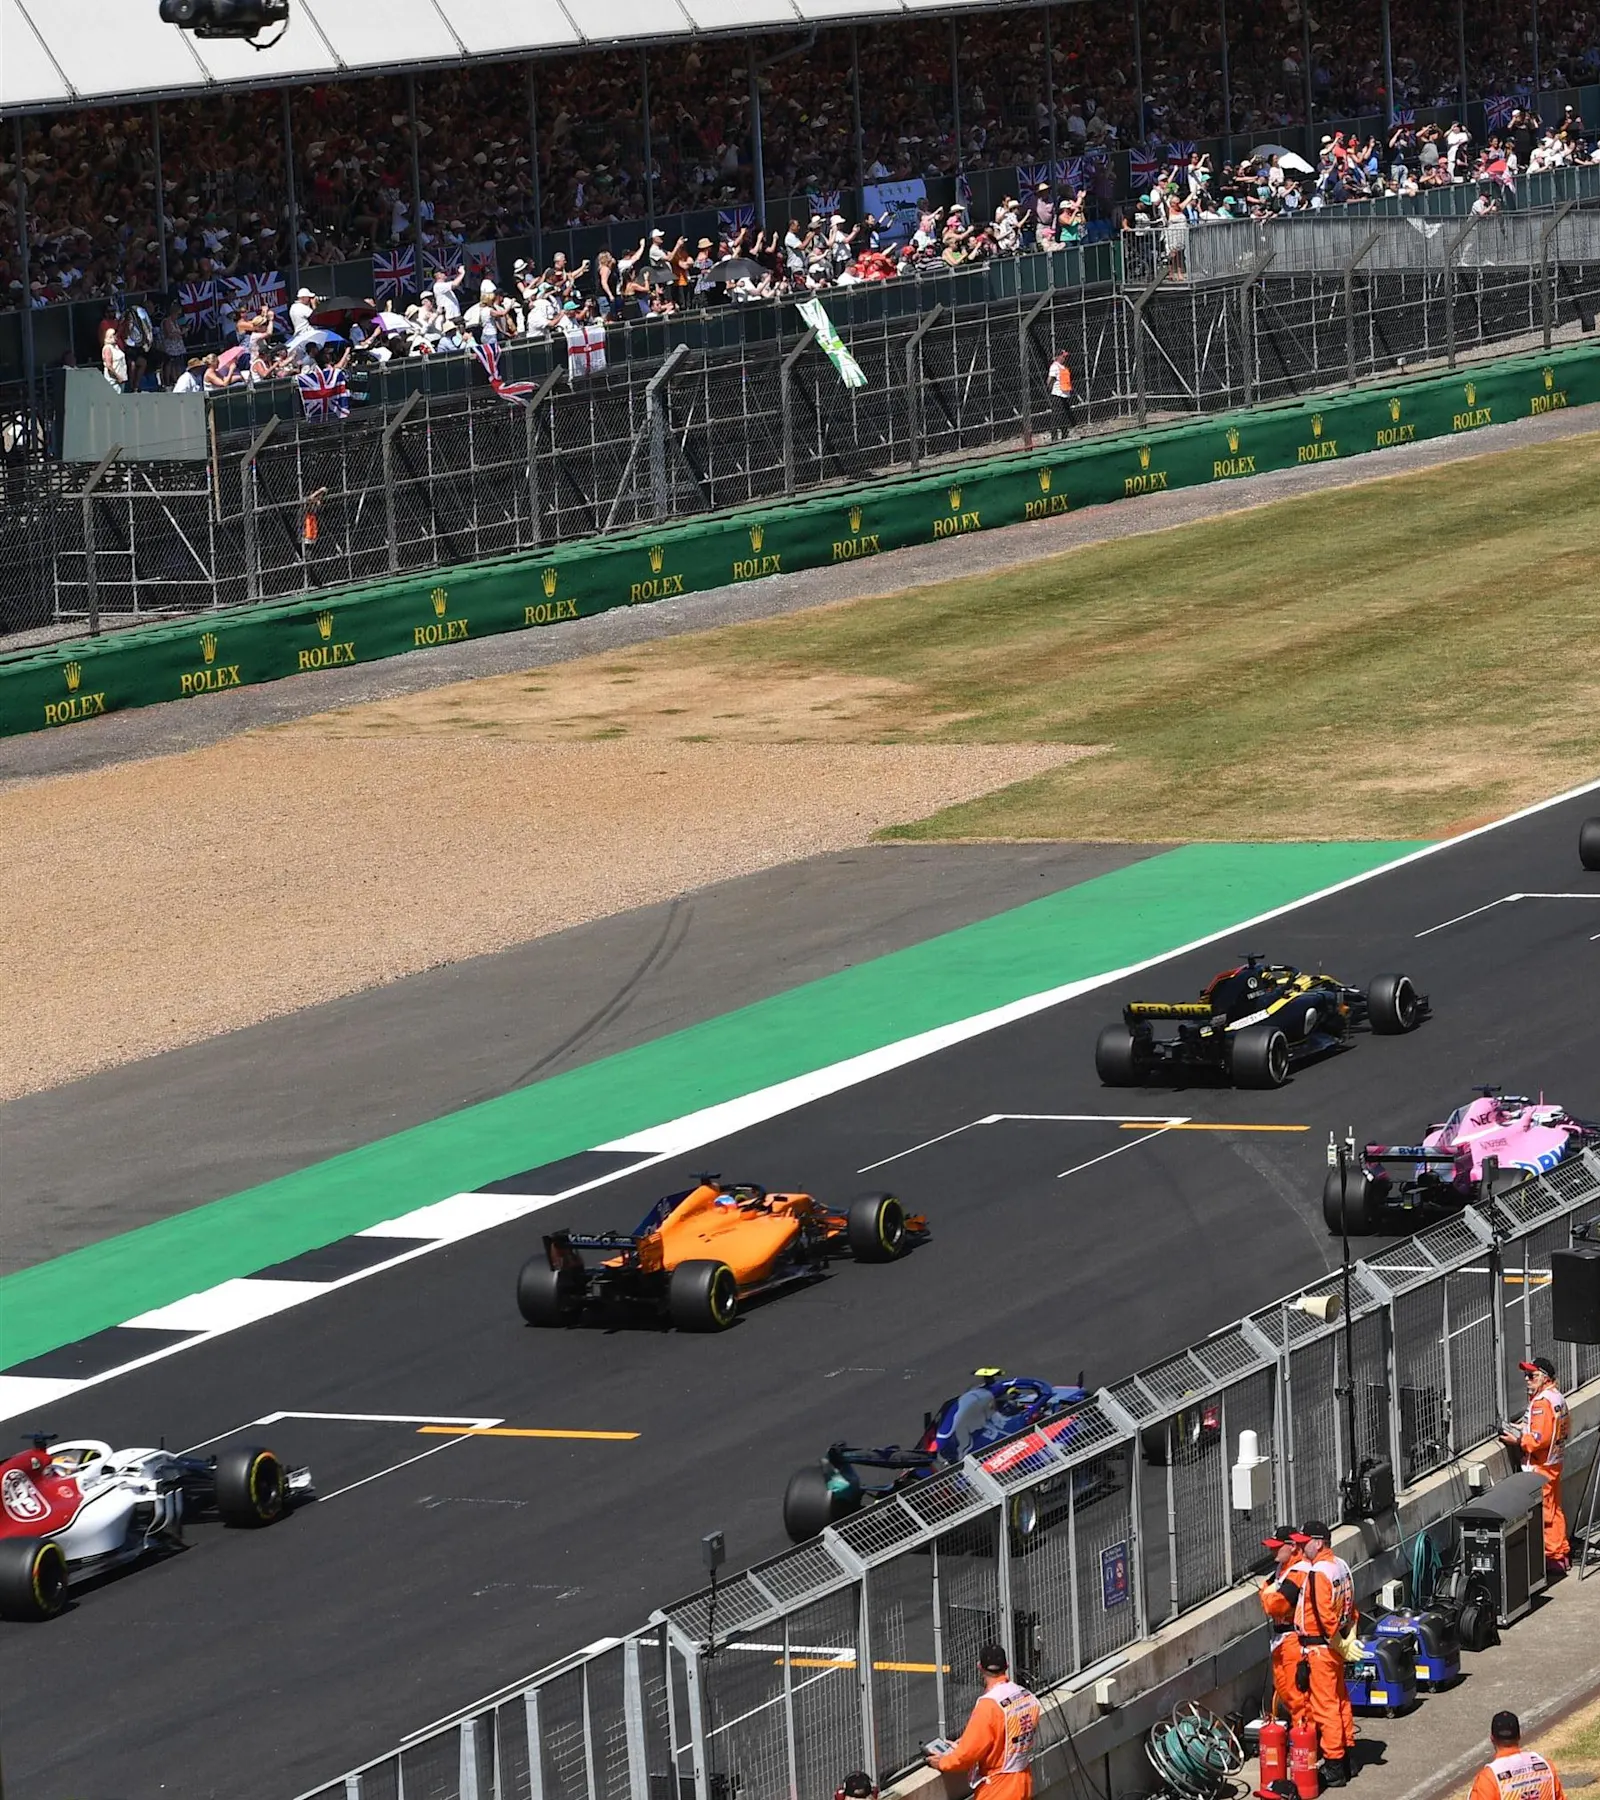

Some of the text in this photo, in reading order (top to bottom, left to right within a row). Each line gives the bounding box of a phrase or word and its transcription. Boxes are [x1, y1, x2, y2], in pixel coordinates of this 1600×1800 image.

[1453, 408, 1491, 430] ROLEX
[1377, 425, 1415, 445] ROLEX
[1298, 441, 1337, 462] ROLEX
[1214, 456, 1255, 478] ROLEX
[1125, 471, 1168, 495] ROLEX
[1025, 494, 1068, 520] ROLEX
[933, 512, 980, 537] ROLEX
[833, 535, 880, 560] ROLEX
[733, 554, 781, 579] ROLEX
[631, 574, 684, 602] ROLEX
[524, 599, 578, 624] ROLEX
[414, 619, 469, 646] ROLEX
[299, 643, 355, 670] ROLEX
[181, 665, 241, 693] ROLEX
[45, 692, 105, 724] ROLEX
[1136, 1005, 1211, 1015] RENAULT
[1470, 1113, 1493, 1128] NEC
[1399, 1147, 1426, 1155] BWT
